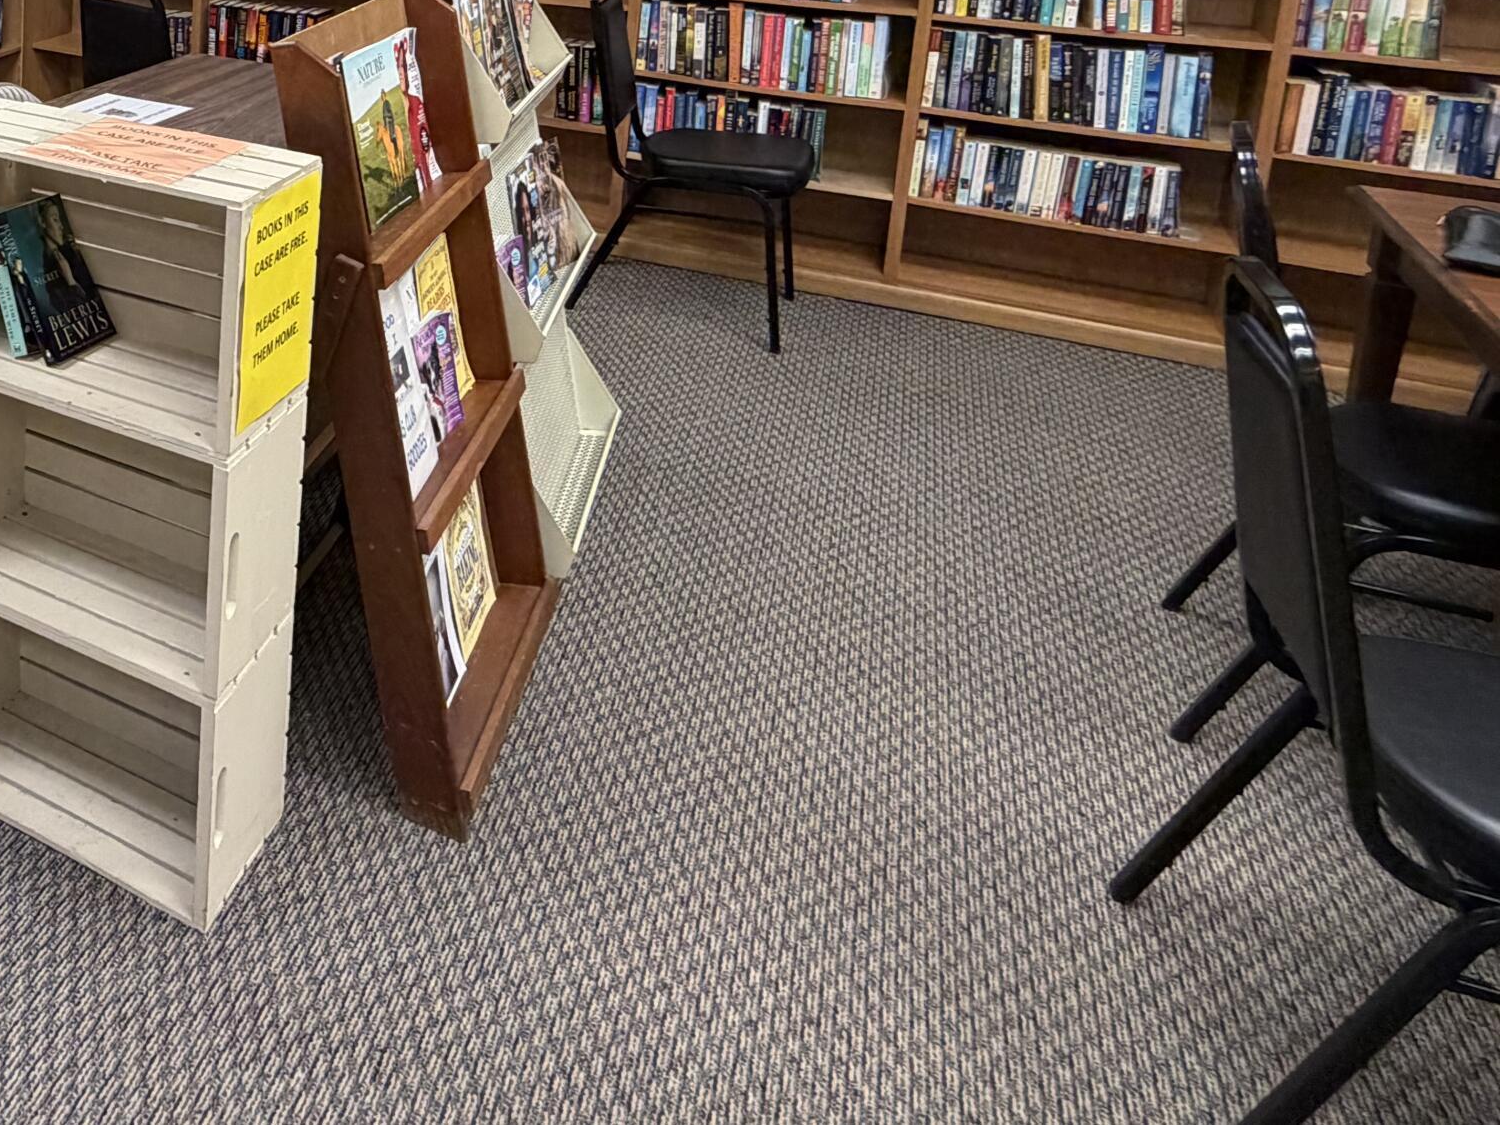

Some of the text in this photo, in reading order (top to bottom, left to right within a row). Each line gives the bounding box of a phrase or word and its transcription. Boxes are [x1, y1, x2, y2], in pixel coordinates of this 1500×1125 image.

[97, 130, 134, 143] CASE
[183, 137, 218, 149] THIS
[256, 200, 309, 245] BOOKS IN THIS
[253, 230, 309, 278] CASE ARE FREE.
[29, 306, 43, 334] SECRET
[47, 299, 101, 332] BEVERLY
[255, 291, 300, 336] PLEASE TAKE
[53, 314, 110, 349] LEWIS
[252, 324, 299, 370] THEM HOME.
